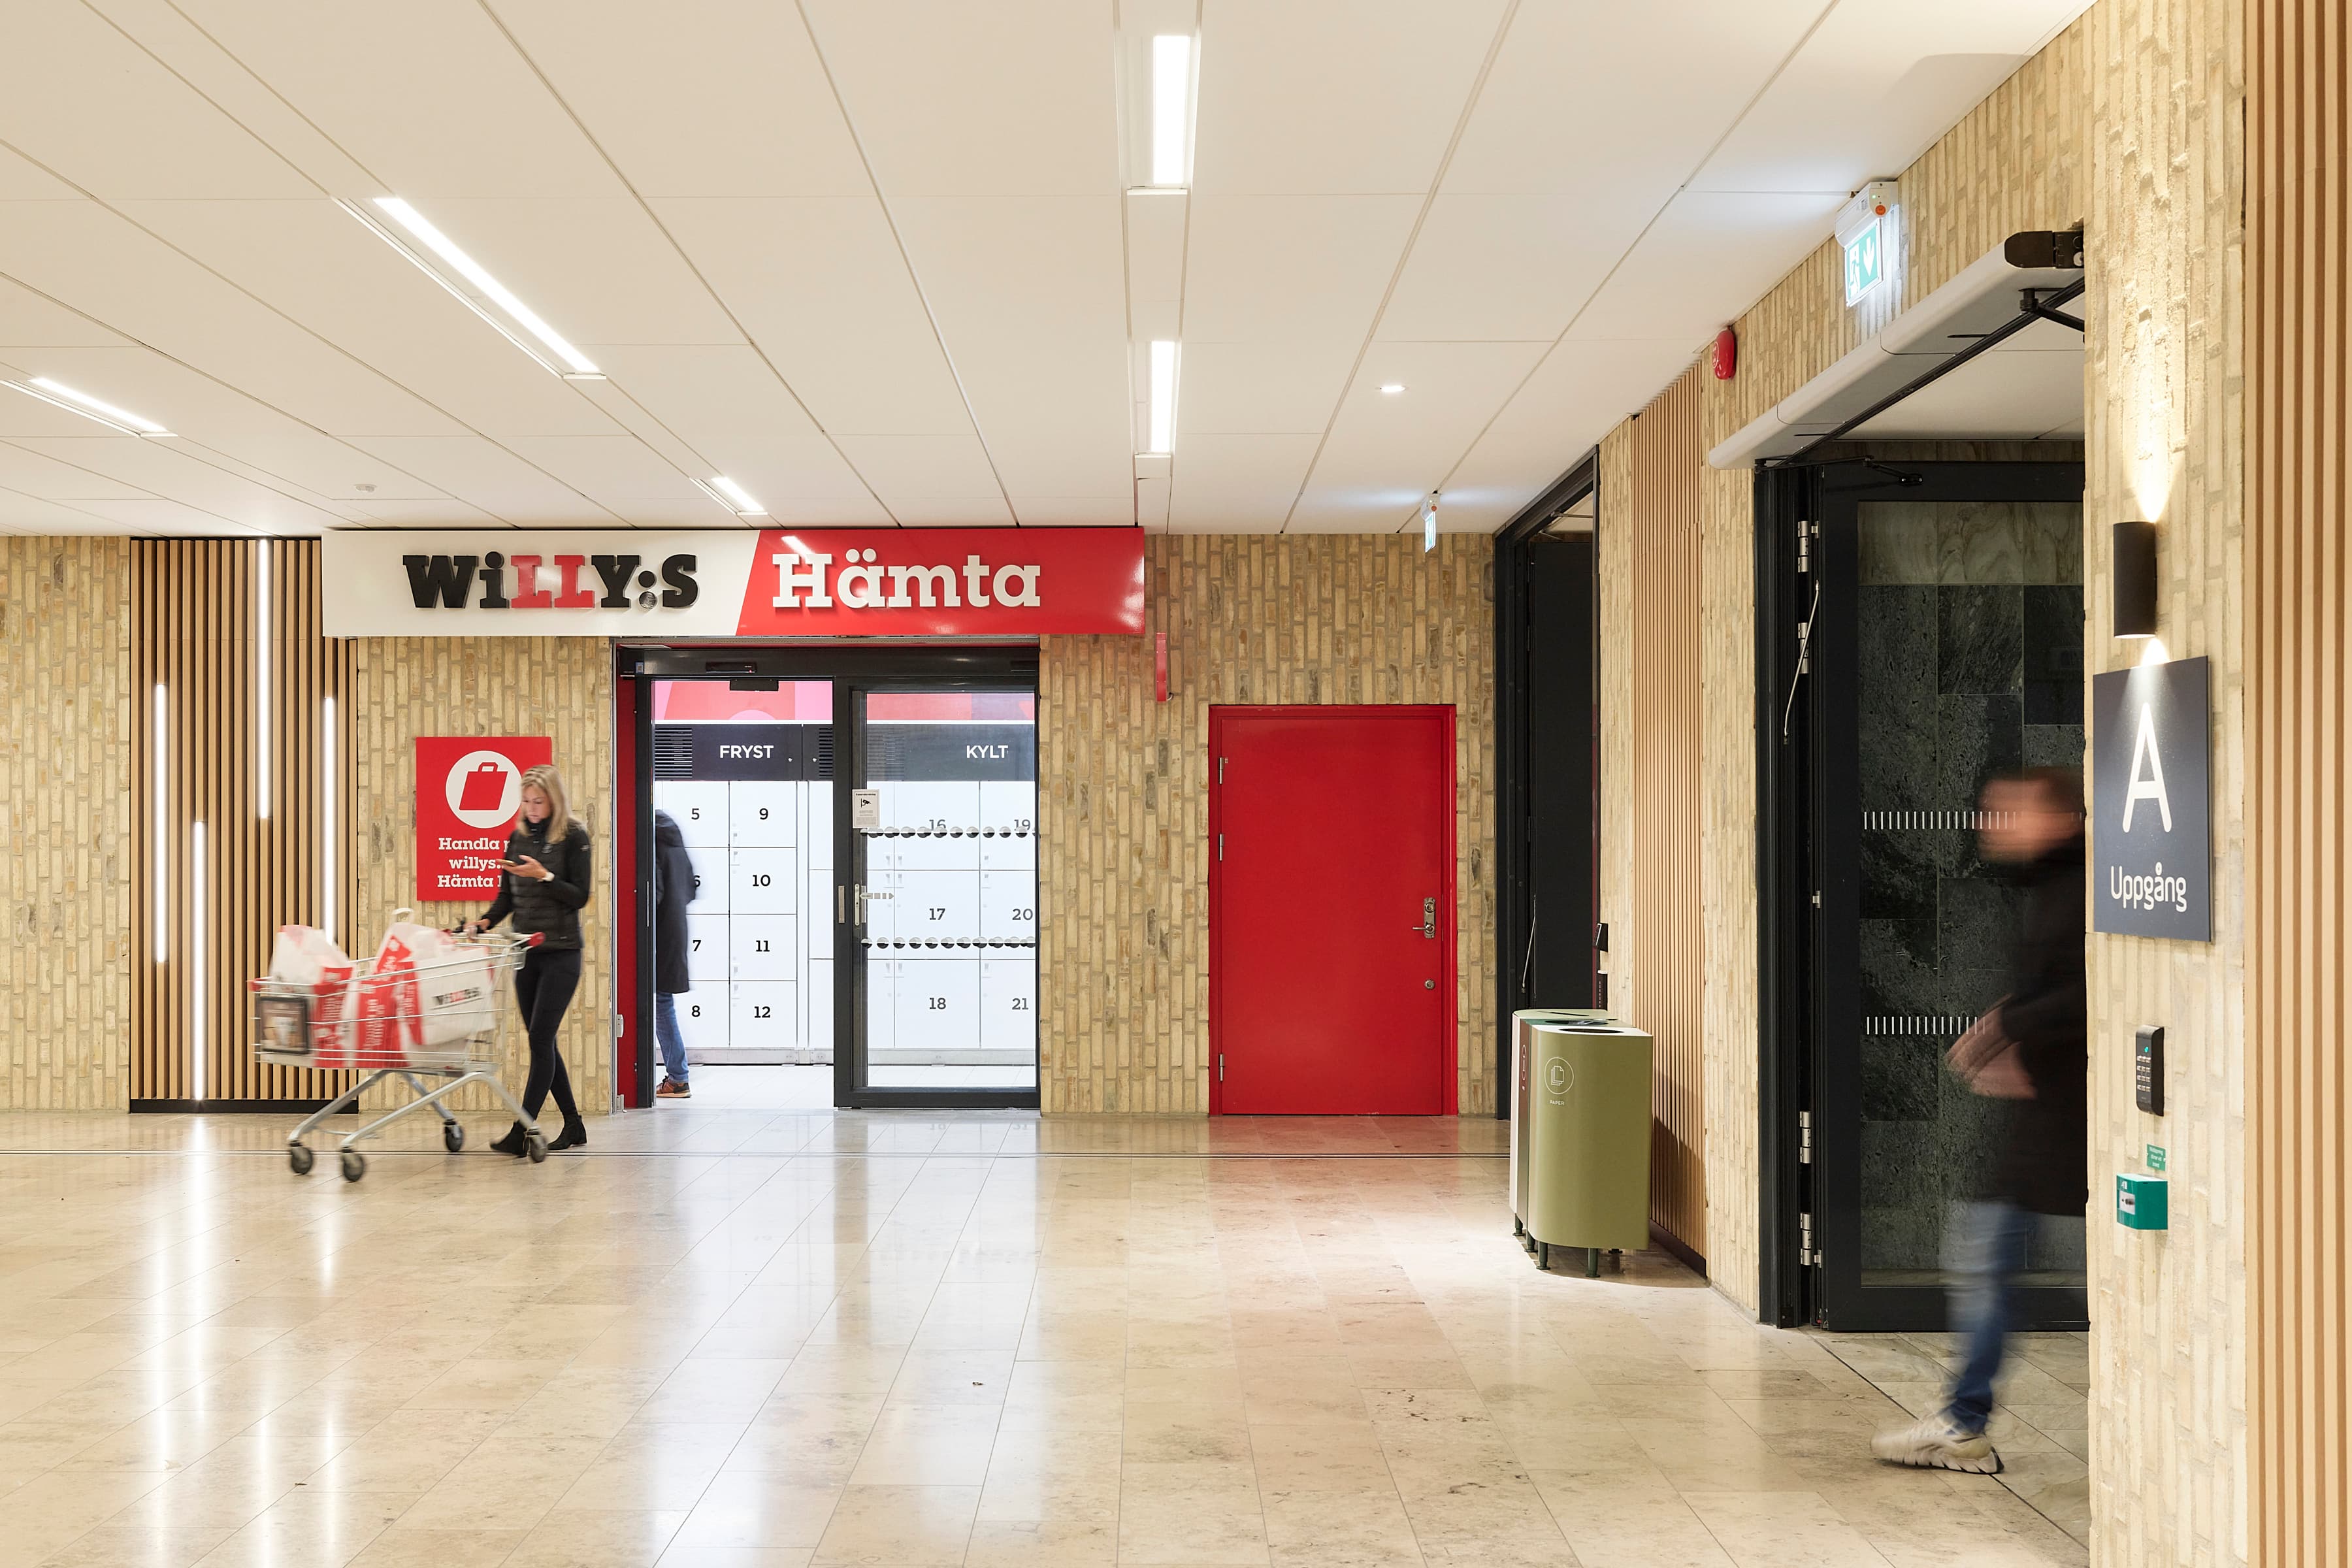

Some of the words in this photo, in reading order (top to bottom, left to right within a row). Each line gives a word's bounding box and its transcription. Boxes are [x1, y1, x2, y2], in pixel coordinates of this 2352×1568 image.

[772, 548, 1041, 608] Hämta
[719, 745, 774, 759] FRYST
[966, 745, 1009, 759] KYLT
[2123, 702, 2172, 833] A
[691, 808, 700, 821] 5
[759, 808, 769, 821] 9
[1013, 819, 1031, 831] 19
[438, 838, 500, 850] Handla
[448, 855, 504, 872] willys.
[437, 874, 494, 888] Hämta
[752, 874, 771, 887] 10
[2110, 862, 2187, 913] Uppgång
[929, 907, 946, 921] 17
[1012, 908, 1033, 921] 20
[693, 939, 702, 952] 7
[755, 939, 770, 953] 11
[929, 997, 947, 1010] 18
[1011, 998, 1029, 1010] 21
[691, 1005, 701, 1018] 8
[754, 1005, 771, 1019] 12
